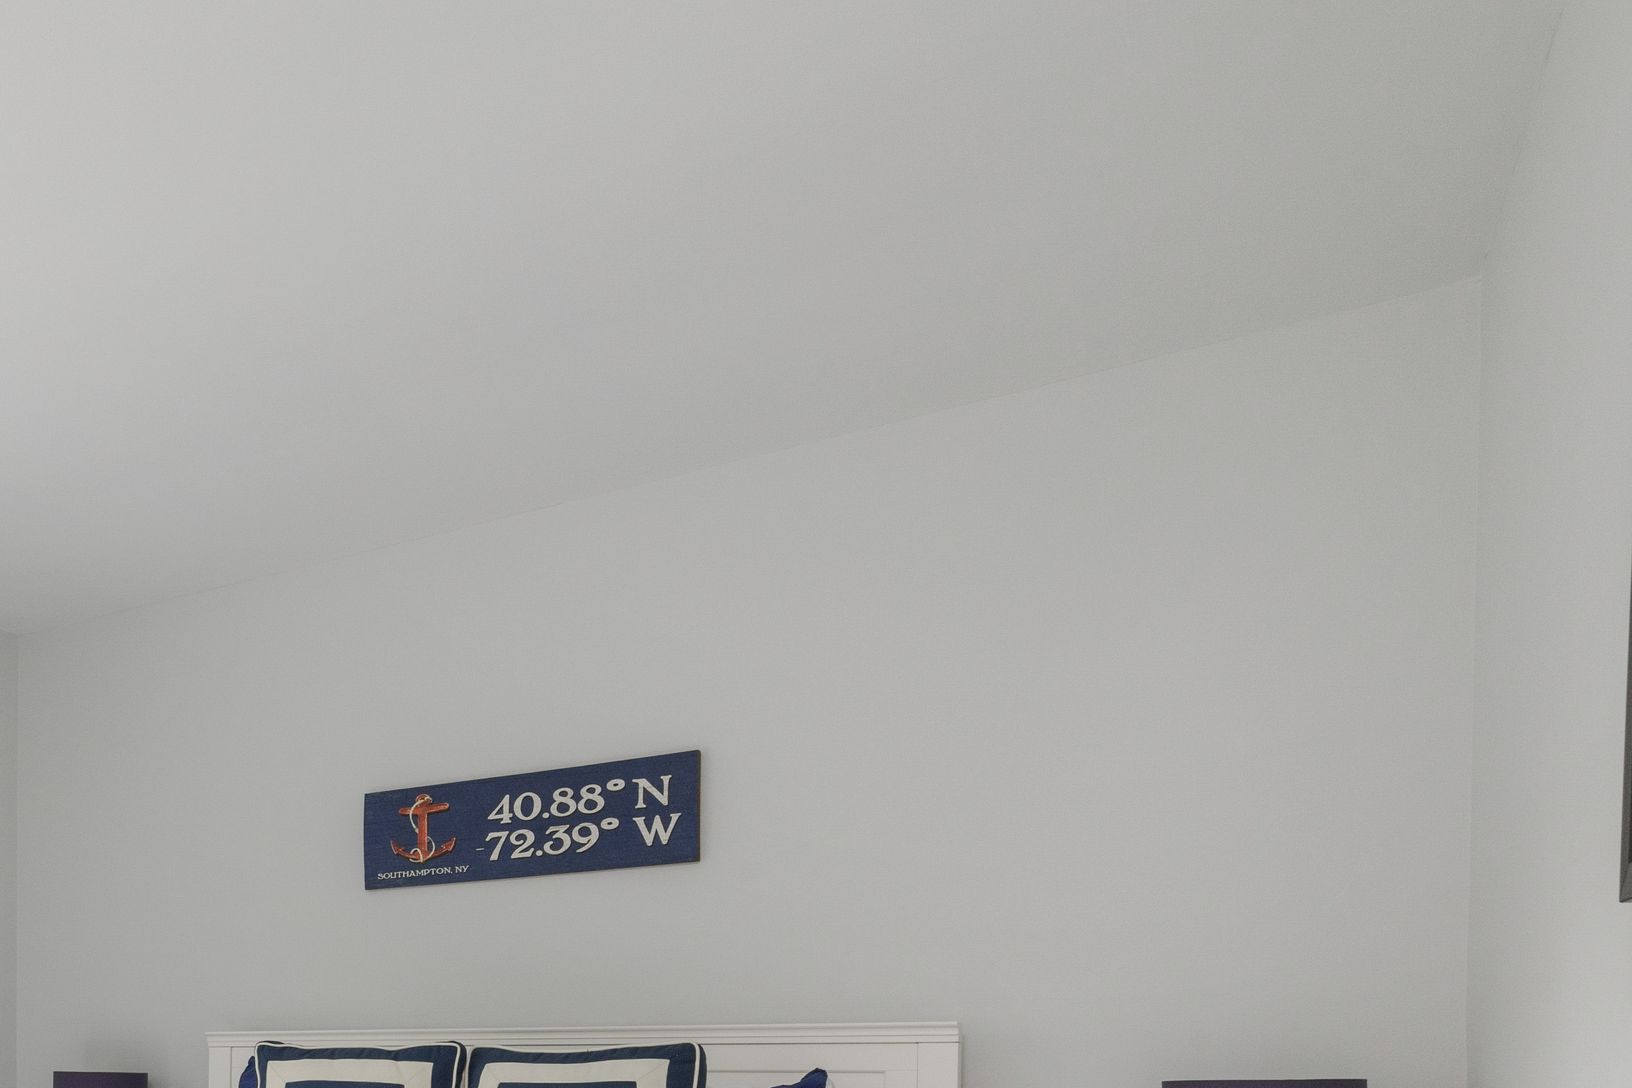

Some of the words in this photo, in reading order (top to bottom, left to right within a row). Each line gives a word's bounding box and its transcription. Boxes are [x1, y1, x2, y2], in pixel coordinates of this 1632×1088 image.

[632, 775, 673, 809] N
[632, 812, 682, 847] W
[455, 865, 469, 873] NY
